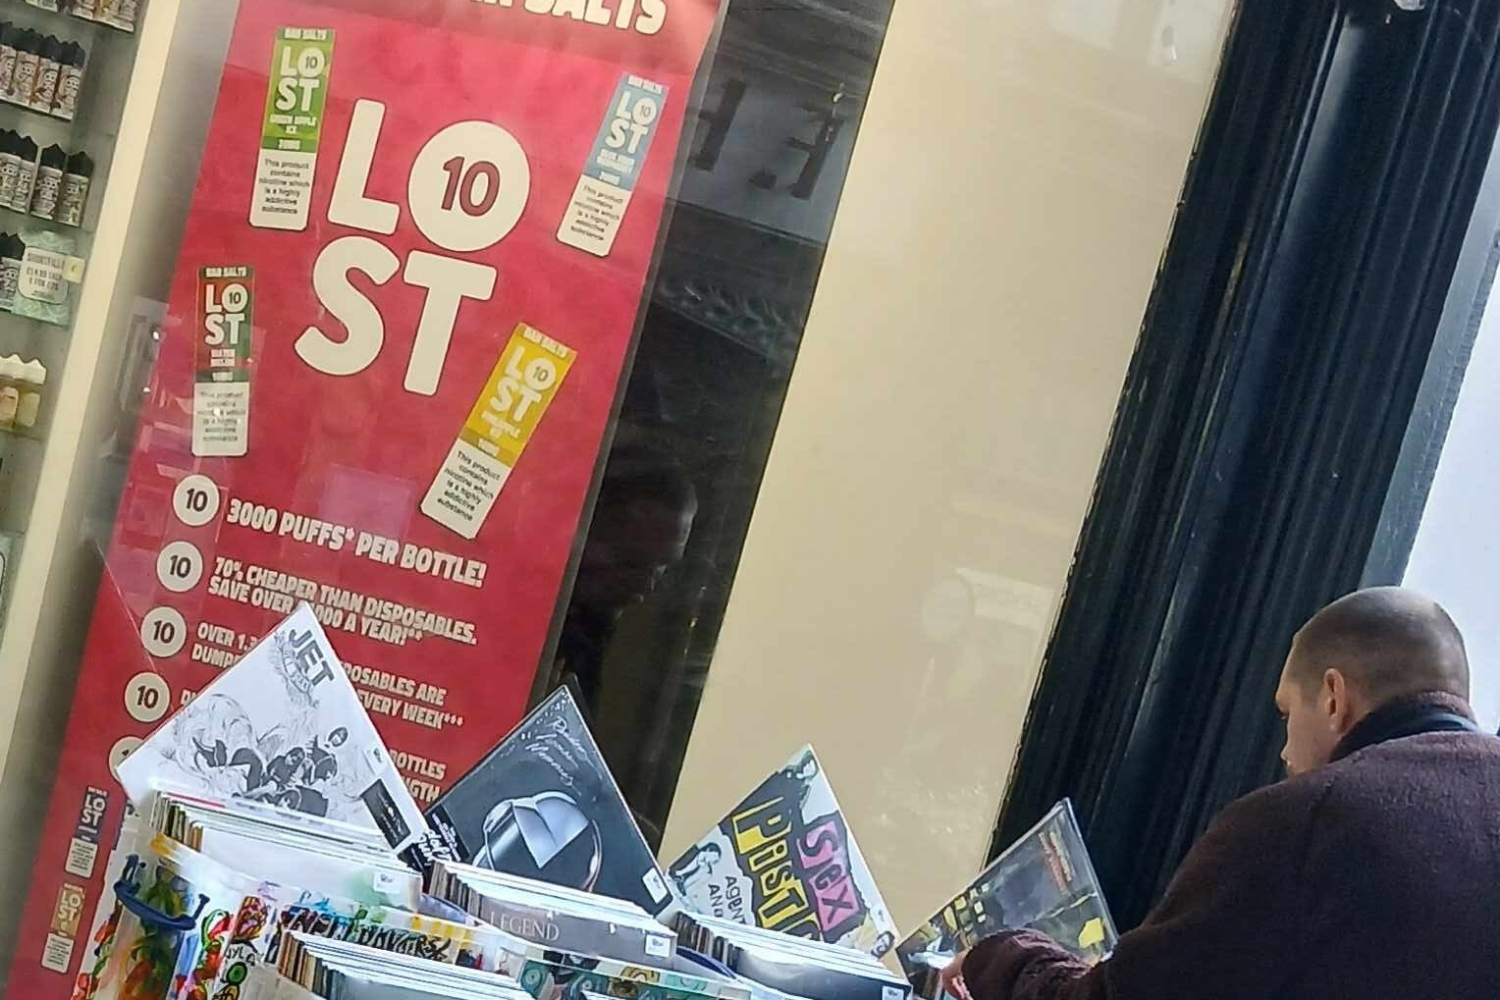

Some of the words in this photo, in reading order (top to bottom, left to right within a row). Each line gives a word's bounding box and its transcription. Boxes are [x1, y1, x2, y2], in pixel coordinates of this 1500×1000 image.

[442, 155, 500, 217] 10
[185, 487, 208, 512] 10
[227, 499, 277, 533] 3000
[355, 532, 399, 565] PER
[400, 544, 487, 589] BOTTLE!
[169, 553, 191, 579] 10
[214, 557, 244, 583] 70%
[246, 565, 319, 602] CHEAPER
[320, 584, 365, 614] THAN
[364, 597, 478, 646] DISPOSABLES.
[209, 576, 249, 604] SAVE
[252, 588, 294, 615] OVER
[343, 612, 357, 633] A
[153, 619, 175, 644] 10
[197, 621, 235, 647] OVER
[288, 628, 334, 687] JET
[137, 685, 159, 709] 10
[415, 682, 447, 706] ARE
[489, 910, 560, 942] LEGEND
